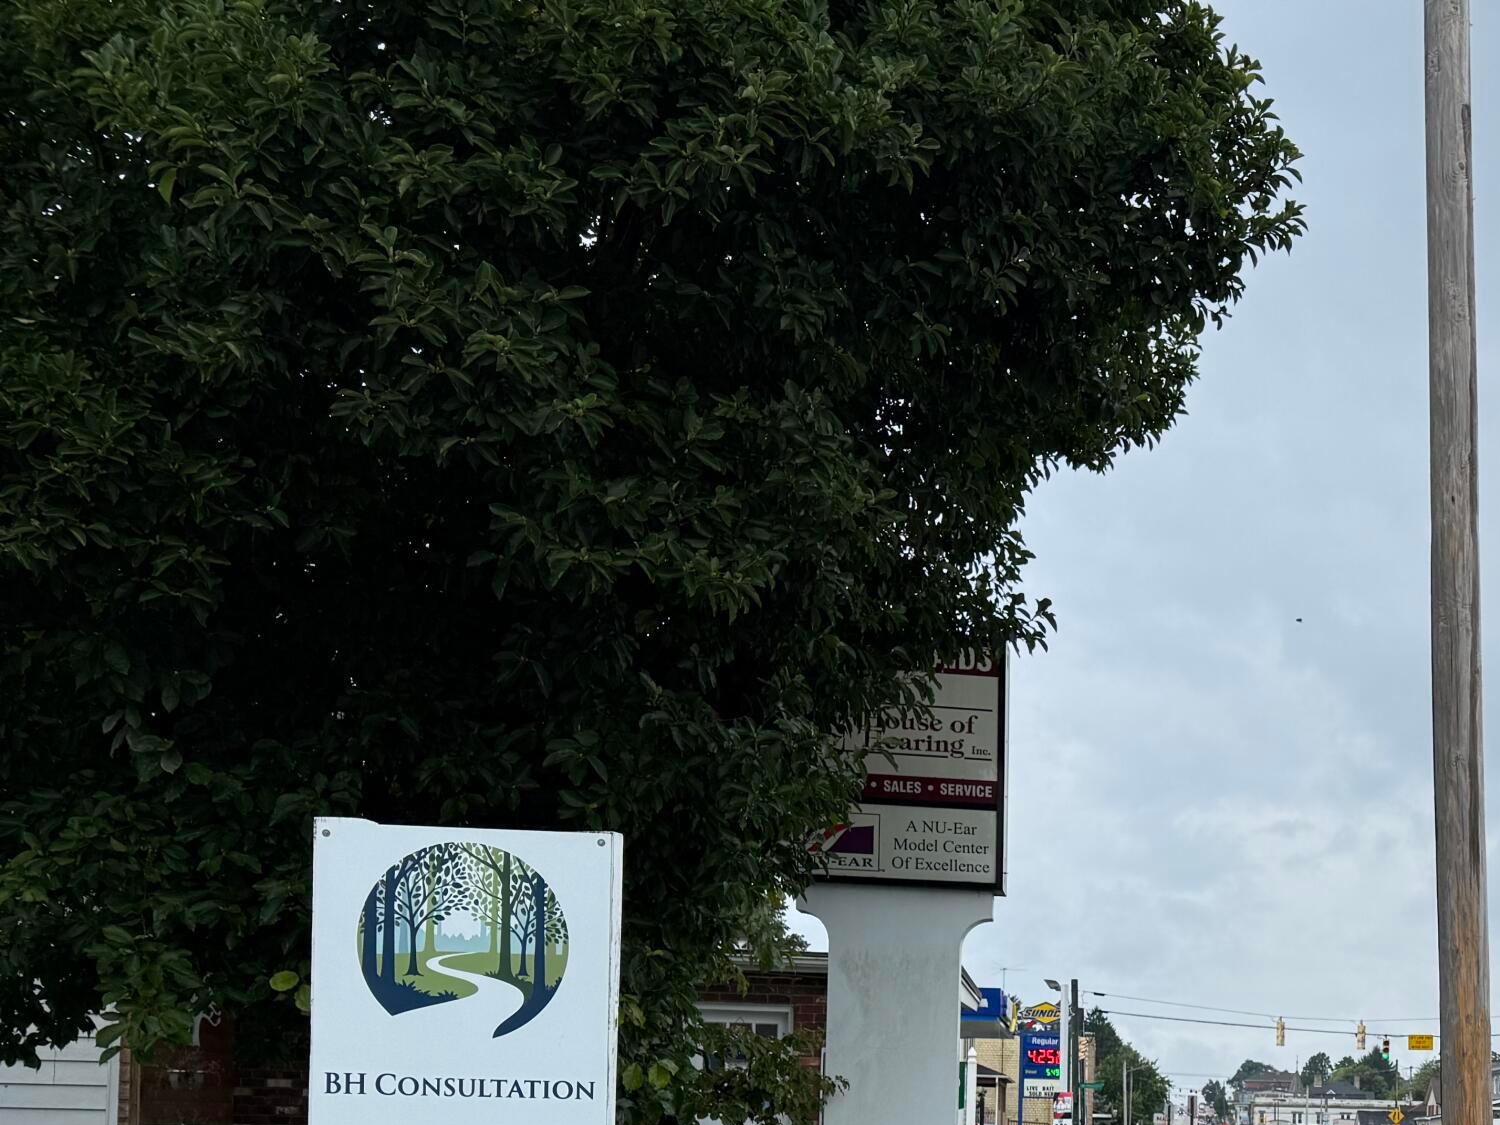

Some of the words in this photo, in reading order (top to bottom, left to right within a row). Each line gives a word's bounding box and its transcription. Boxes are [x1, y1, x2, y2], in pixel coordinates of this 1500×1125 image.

[950, 715, 978, 735] of
[972, 746, 991, 756] Inc.
[883, 780, 922, 794] SALES
[940, 783, 993, 798] SERVICE
[905, 820, 918, 833] A
[922, 821, 978, 835] NU-Ear
[894, 838, 938, 852] Model
[943, 840, 990, 855] Center
[892, 856, 911, 870] Of
[915, 858, 990, 873] Excellence
[1024, 1008, 1060, 1018] SUNOC
[1032, 1036, 1058, 1046] Regular
[324, 1072, 366, 1096] BH
